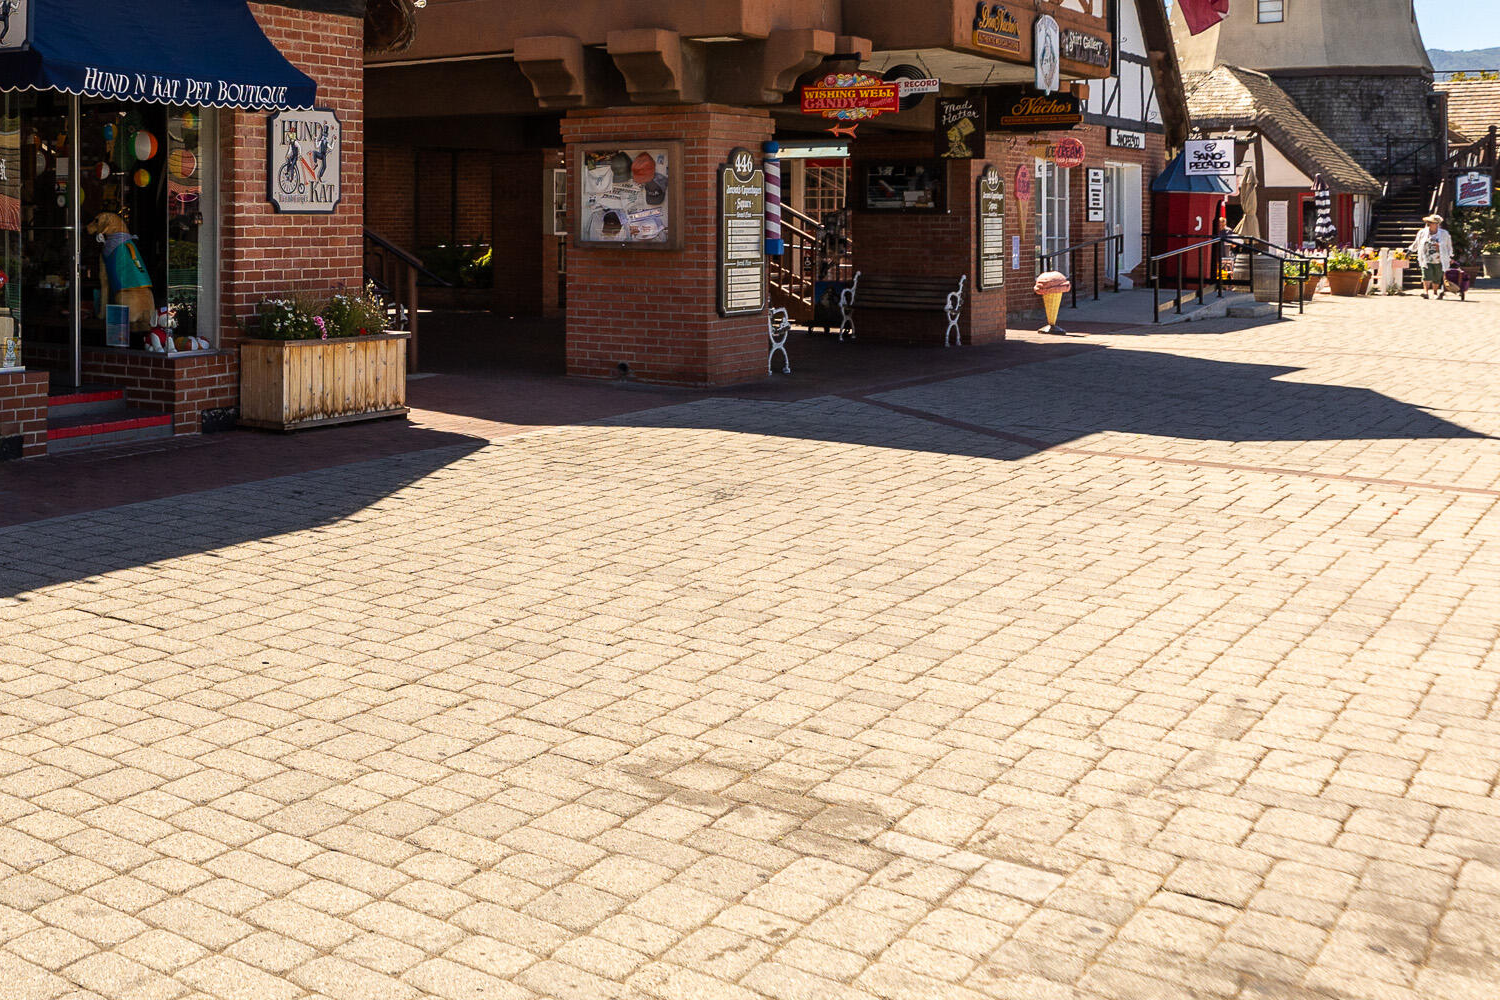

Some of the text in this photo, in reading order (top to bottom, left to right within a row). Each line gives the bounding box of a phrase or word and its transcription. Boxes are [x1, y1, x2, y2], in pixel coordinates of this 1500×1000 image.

[84, 67, 288, 104] HUND N KAT PET BOUTIQUE
[904, 79, 938, 88] RECORD
[804, 89, 895, 99] WISHING WELL
[804, 98, 858, 109] CANDY
[944, 100, 973, 115] Mad
[1011, 96, 1072, 116] Nacho's
[942, 110, 980, 125] Hatter
[280, 120, 323, 145] HUND
[1045, 145, 1083, 159] ICE CREAM
[1193, 150, 1223, 161] SANO
[735, 154, 753, 173] 446
[1189, 160, 1231, 170] PECADO
[309, 180, 335, 203] KAT
